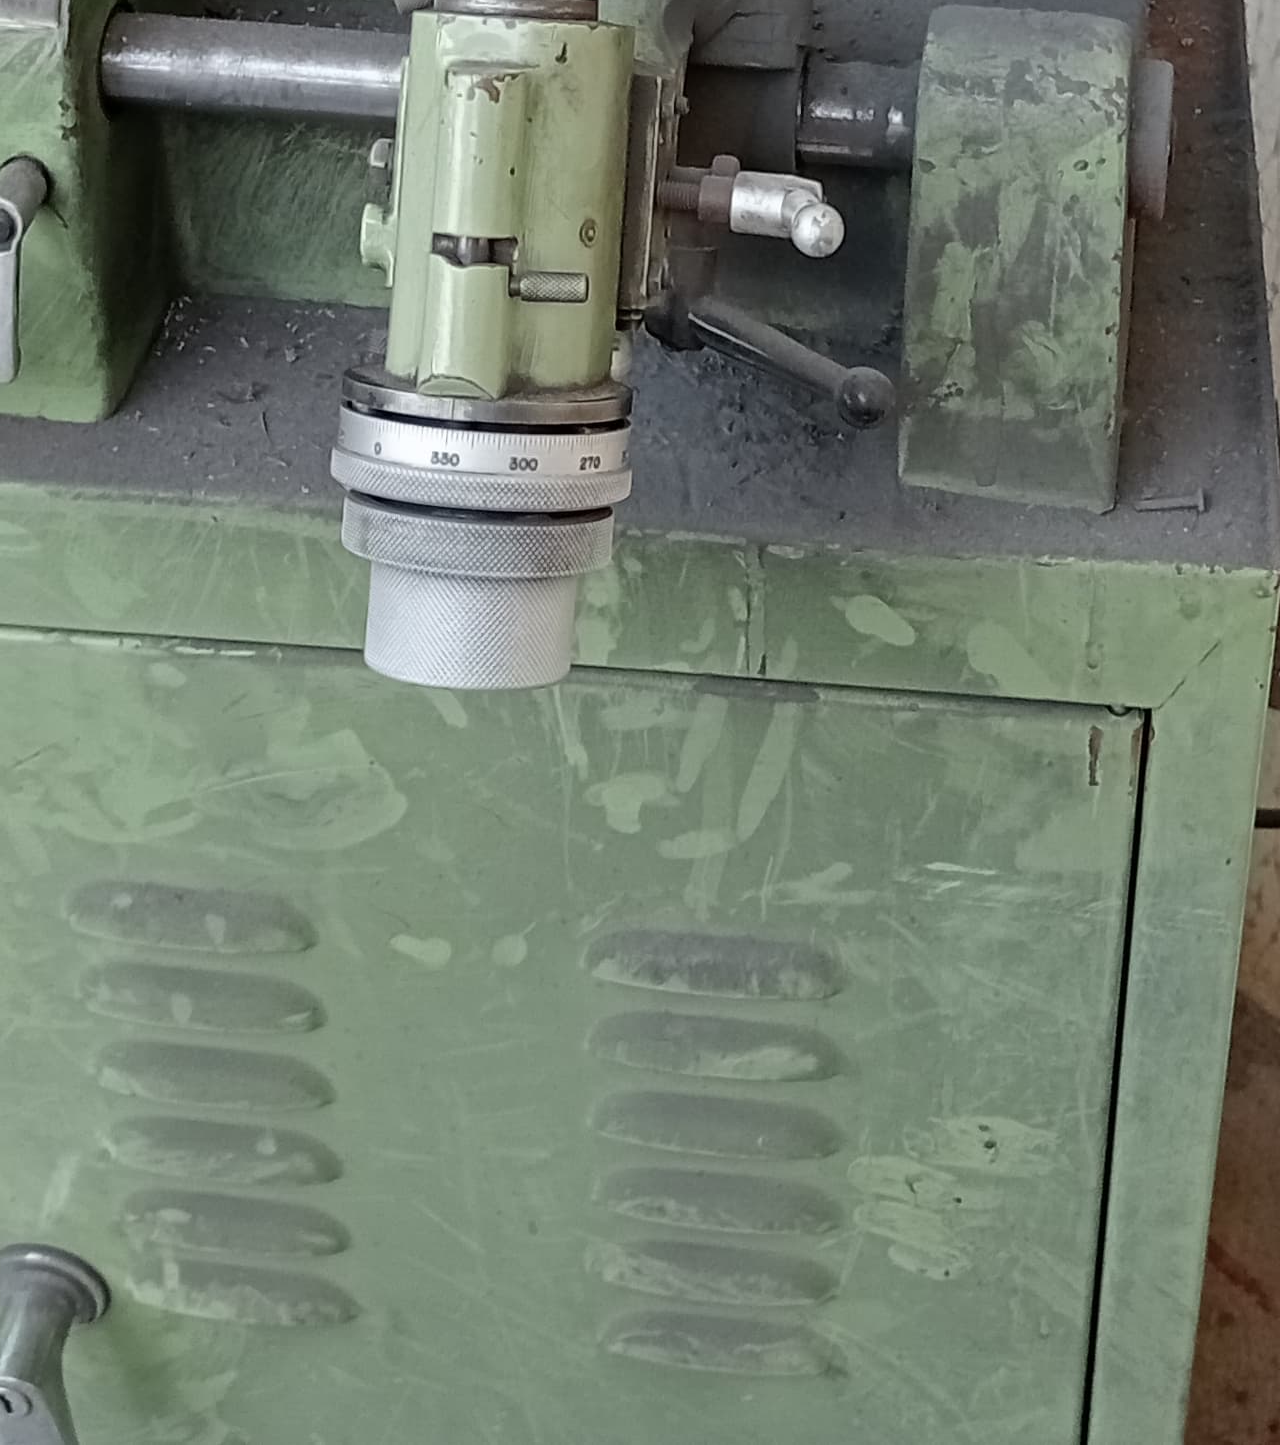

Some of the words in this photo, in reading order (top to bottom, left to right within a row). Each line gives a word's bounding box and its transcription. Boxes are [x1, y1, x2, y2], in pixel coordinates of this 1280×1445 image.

[374, 442, 382, 455] 0
[509, 457, 538, 471] 300
[579, 456, 601, 471] 270
